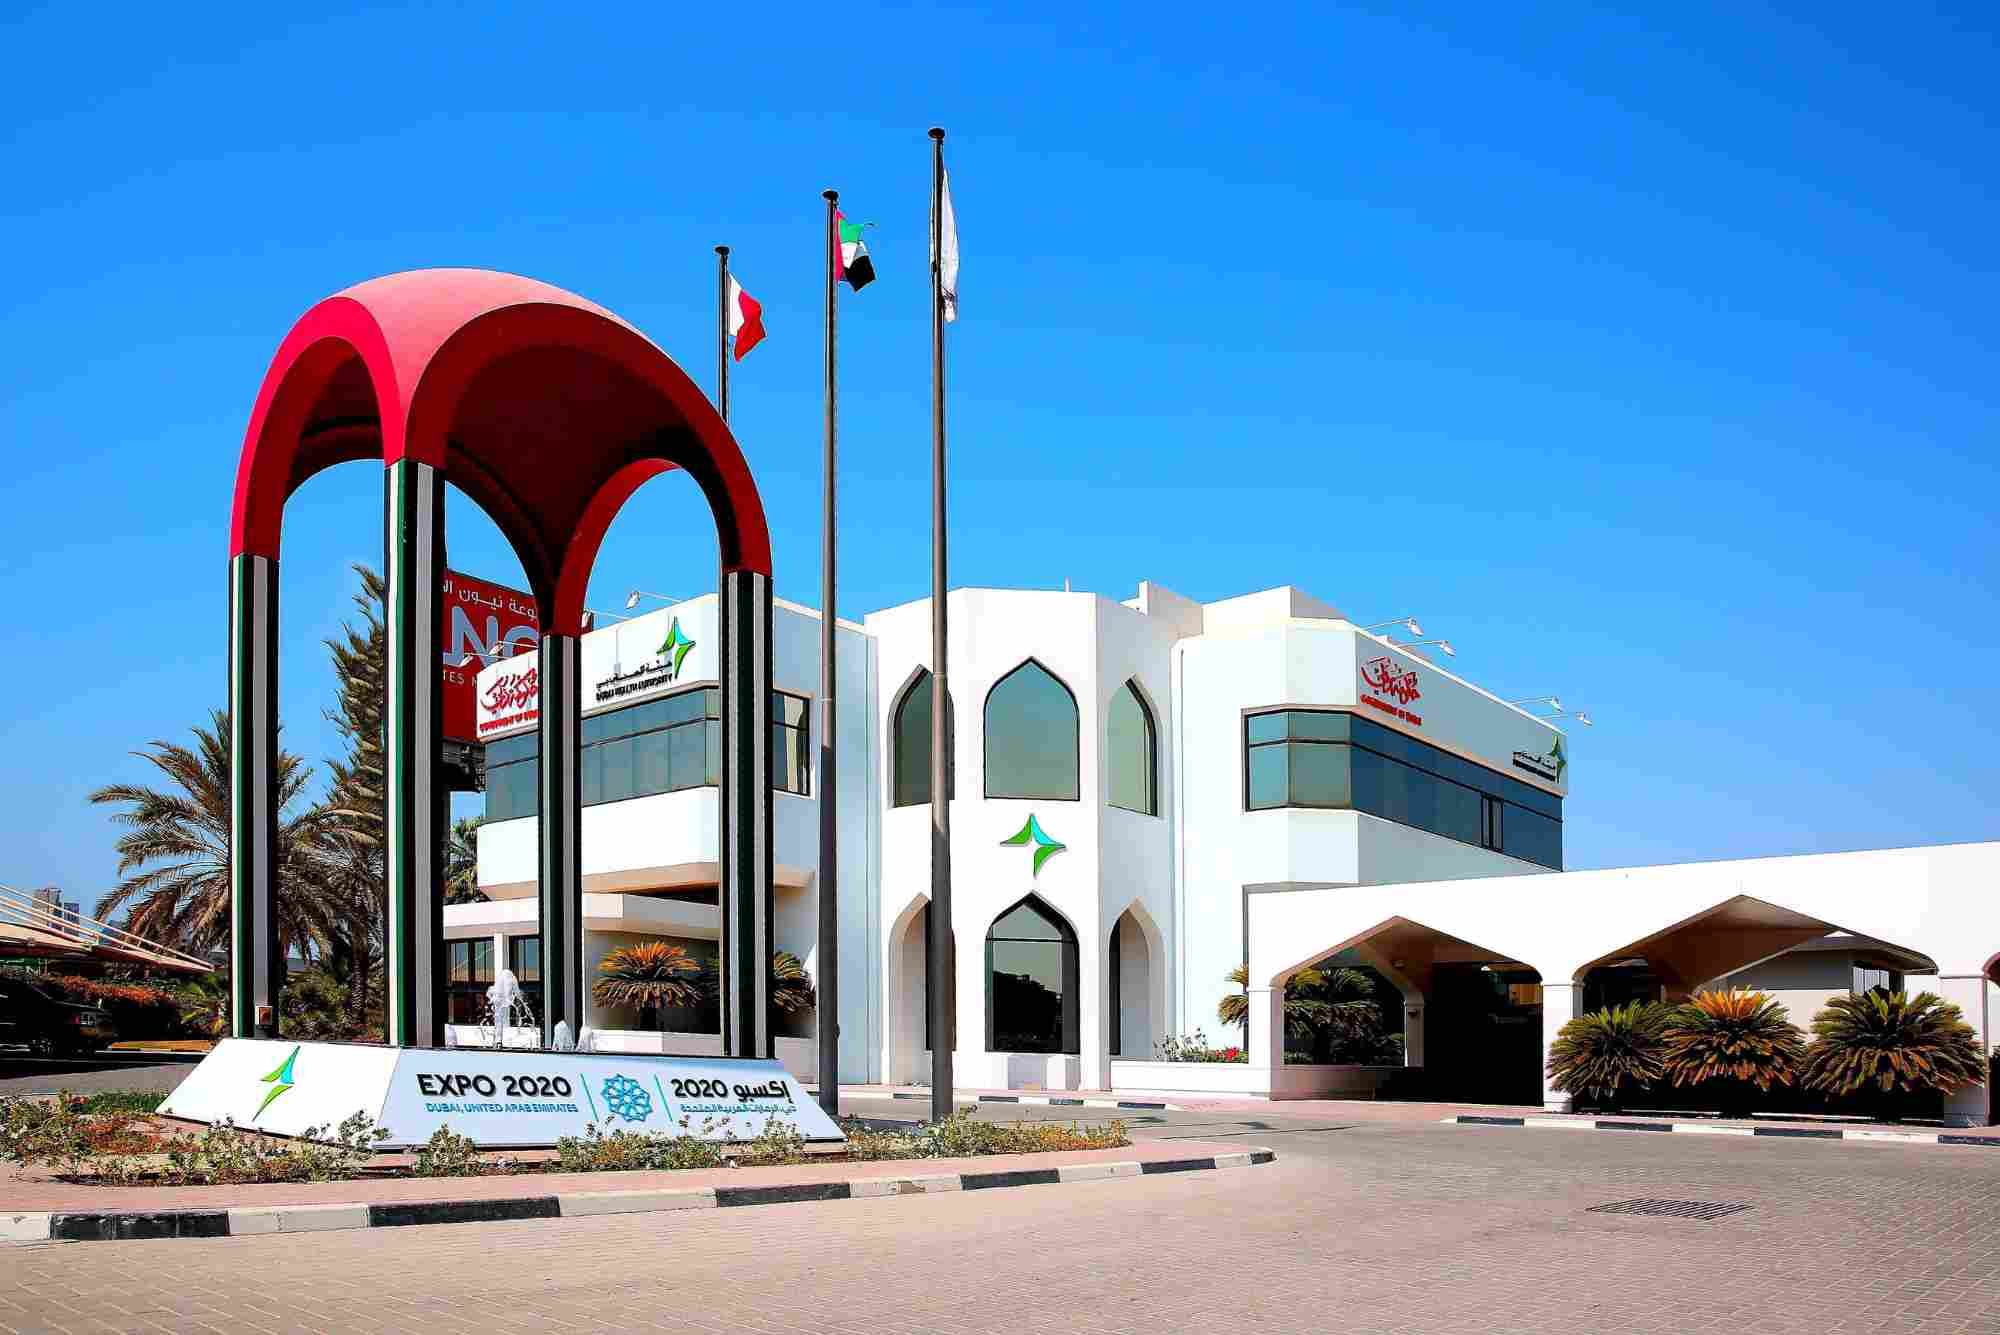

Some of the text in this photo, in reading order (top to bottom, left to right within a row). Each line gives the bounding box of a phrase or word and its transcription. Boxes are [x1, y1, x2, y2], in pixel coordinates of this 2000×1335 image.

[417, 1073, 572, 1097] EXPO 2020
[670, 1079, 793, 1104] إكسبو 2020
[425, 1103, 579, 1114] DUBAI, UNITED ARAB EMIRATES
